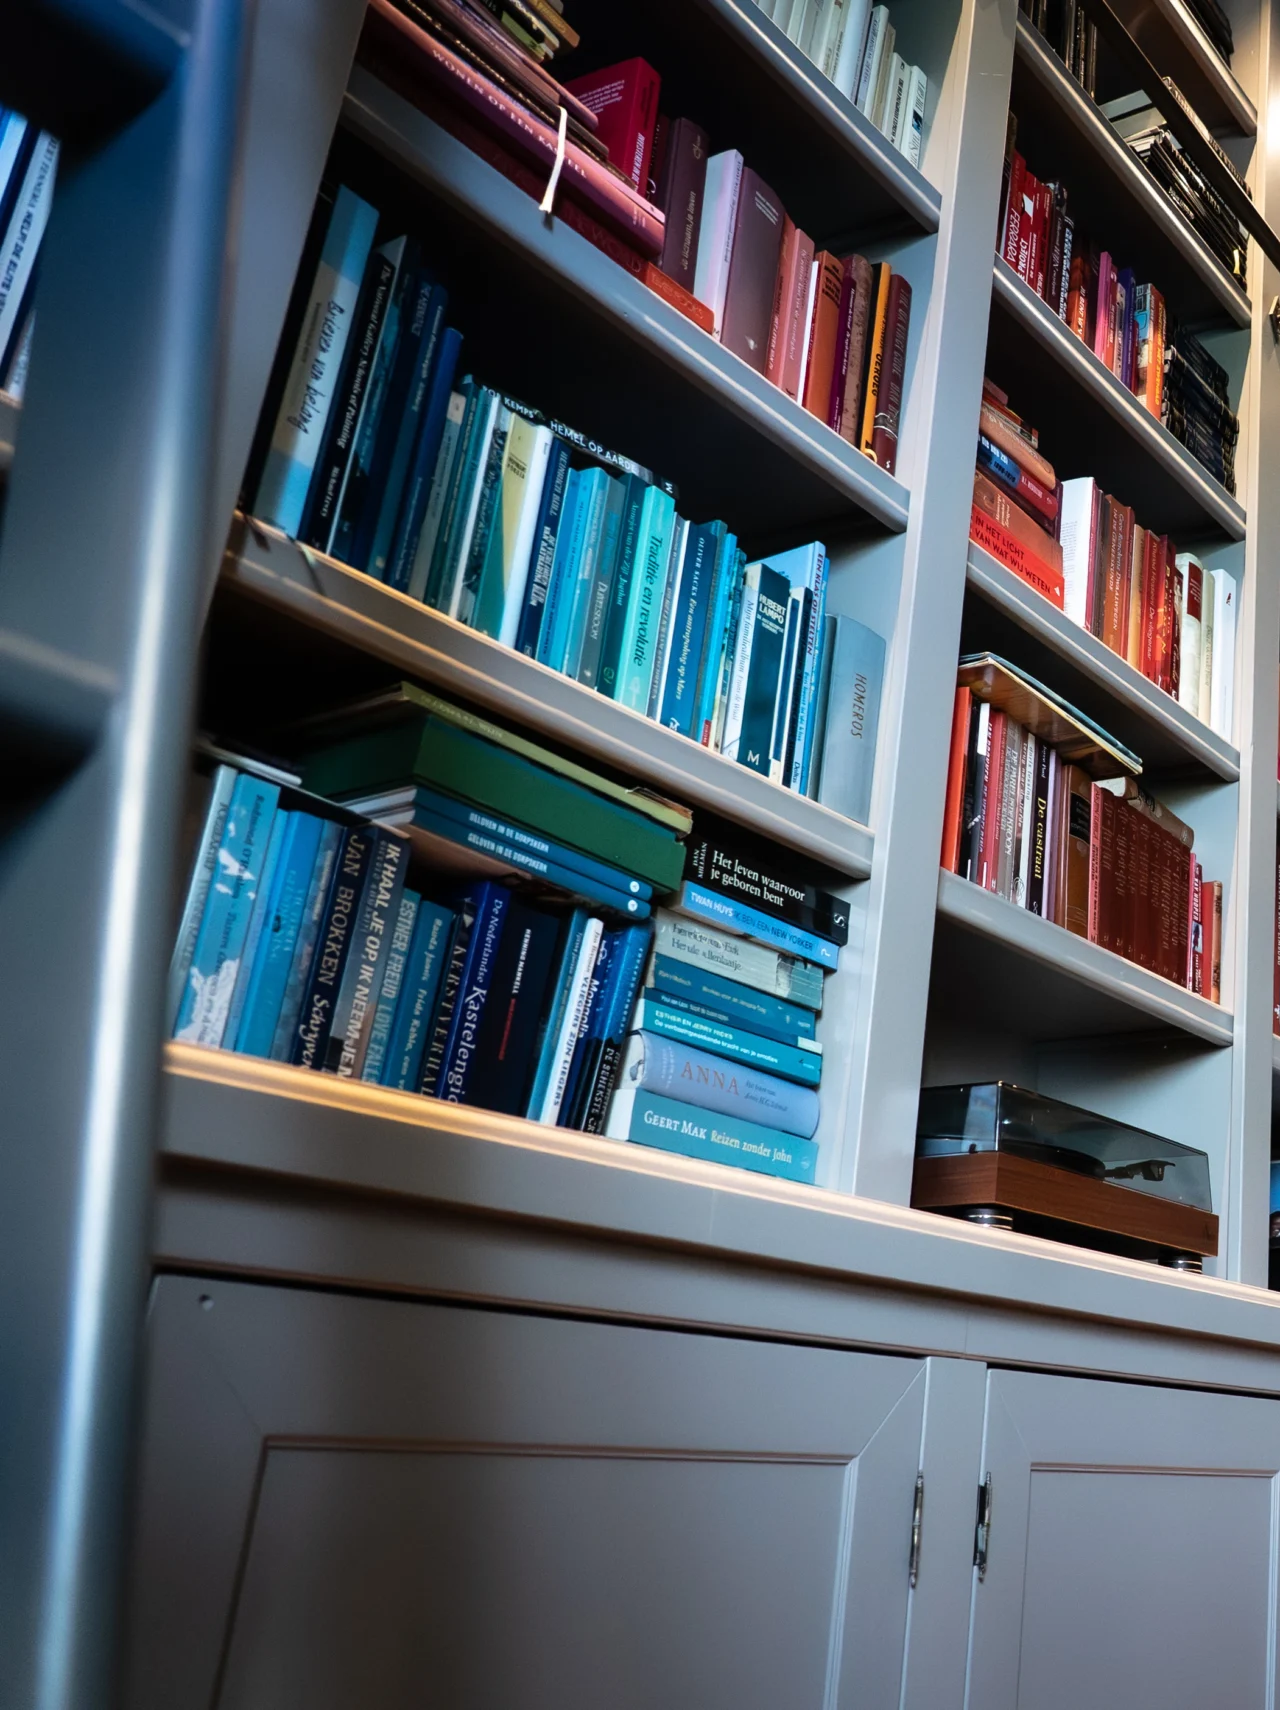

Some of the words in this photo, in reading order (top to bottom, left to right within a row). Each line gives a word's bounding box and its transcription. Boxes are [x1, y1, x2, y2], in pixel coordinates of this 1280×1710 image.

[433, 48, 482, 95] WONEN
[488, 93, 504, 112] OP
[511, 112, 532, 134] EEN
[539, 133, 585, 178] KAEEL
[12, 240, 24, 258] DE
[1007, 207, 1021, 263] FERRARA
[1018, 237, 1028, 271] PROJECT
[1, 257, 18, 290] ELITE
[1077, 295, 1085, 317] BENT
[310, 358, 327, 381] van
[869, 352, 884, 396] OEROEG
[287, 384, 327, 435] belang
[349, 393, 358, 406] of
[335, 405, 355, 449] Painting
[504, 396, 535, 419] KEMPS
[550, 420, 586, 448] HEMEL
[588, 440, 604, 456] OP
[605, 450, 638, 474] AARDE
[975, 514, 985, 527] IN
[985, 522, 1002, 540] HET
[1002, 534, 1025, 560] LICHT
[1111, 519, 1117, 531] DE
[643, 534, 663, 585] Traditie
[694, 536, 705, 568] OLIVER
[815, 553, 824, 573] EEN
[974, 529, 991, 547] VAN
[991, 542, 1009, 560] WAT
[1010, 556, 1024, 574] WIJ
[1025, 566, 1052, 595] WETEN
[1106, 531, 1117, 591] GENEESKUNDE
[641, 585, 653, 604] en
[690, 569, 700, 597] SACKS
[812, 572, 822, 598] KLAS
[687, 597, 697, 615] Een
[759, 593, 787, 616] HUBERT
[759, 605, 784, 625] LAMPO
[810, 598, 819, 613] OP
[1112, 571, 1121, 630] DWAALWEGEN
[1148, 606, 1154, 619] De
[630, 606, 653, 667] revolutie
[678, 615, 693, 663] antropoloog
[737, 619, 754, 673] familiealbum
[805, 614, 817, 655] STELTEN
[1145, 620, 1155, 660] vliegeraar
[677, 664, 685, 676] op
[849, 672, 869, 739] HOMEROS
[1010, 750, 1018, 765] DE
[1008, 765, 1017, 797] PAREL
[1024, 770, 1032, 801] lessing
[1035, 797, 1047, 818] De
[469, 830, 493, 853] GELOVEN
[496, 843, 502, 855] IN
[498, 823, 503, 835] IN
[1004, 816, 1014, 855] KROON
[342, 833, 365, 876] JAN
[385, 843, 400, 862] IK
[1031, 821, 1047, 879] castraat
[375, 862, 397, 910] HAAL
[710, 864, 721, 880] je
[722, 873, 762, 898] geboren
[763, 887, 785, 907] bent
[712, 850, 733, 870] Het
[734, 859, 760, 882] leven
[761, 875, 806, 902] waarvoor
[370, 910, 386, 935] JE
[491, 898, 502, 915] De
[690, 890, 714, 911] TWAN
[713, 902, 735, 918] HUYS
[770, 925, 788, 940] NEW
[788, 933, 814, 952] YORKER
[1191, 893, 1200, 921] HOOPER
[317, 884, 353, 986] BROKKEN
[391, 897, 415, 951] ESTHER
[363, 934, 380, 962] OP,
[475, 915, 500, 984] Nederlandse
[518, 928, 532, 961] HENNING
[359, 963, 374, 983] IK
[380, 951, 403, 1000] FREUD
[511, 960, 525, 995] MANKELL
[345, 983, 370, 1041] NEEM
[413, 987, 426, 1016] Frida
[570, 976, 590, 1029] VLIEGERS
[573, 977, 601, 1040] Mongolia
[371, 1003, 391, 1041] LOVE
[656, 1007, 680, 1025] ESTHER
[682, 1018, 690, 1027] EN
[693, 1020, 711, 1035] JERRY
[714, 1028, 731, 1041] HICKS
[340, 1038, 357, 1065] JE
[564, 1031, 576, 1057] ZIJN
[604, 1047, 614, 1062] DE
[552, 1059, 569, 1107] LIEGERS
[680, 1061, 740, 1096] ANNA
[646, 1109, 677, 1132] GEERT
[683, 1121, 705, 1140] MAK
[711, 1129, 739, 1149] Reizen
[743, 1139, 769, 1157] zonder
[774, 1148, 791, 1165] John
